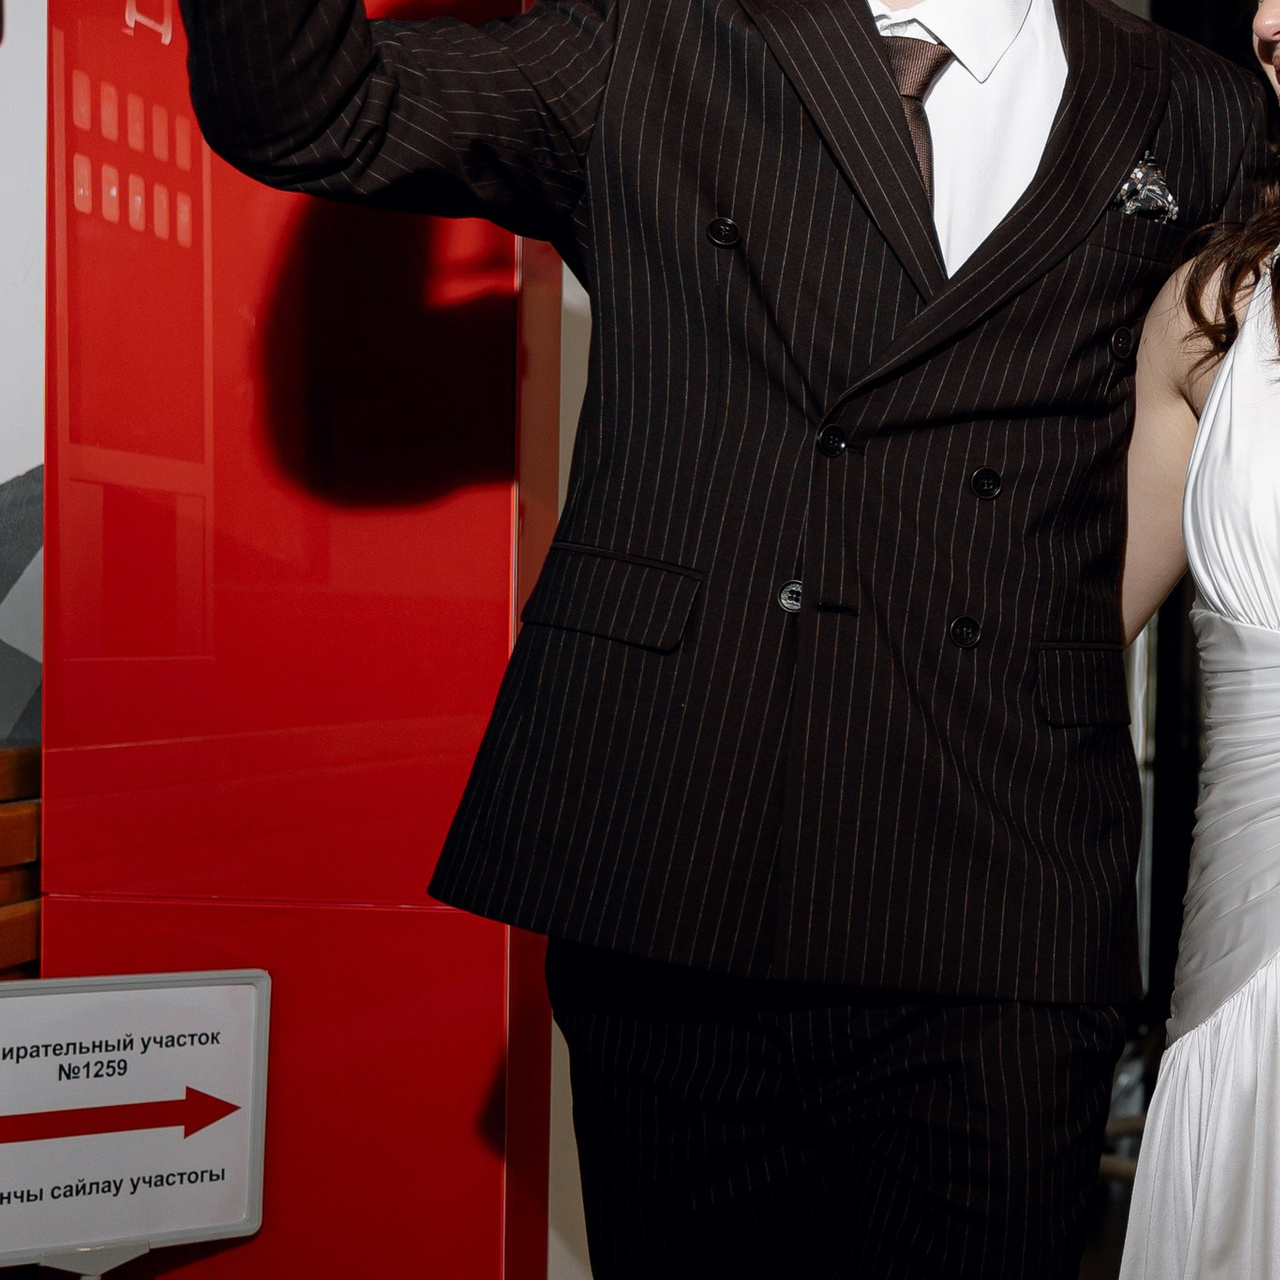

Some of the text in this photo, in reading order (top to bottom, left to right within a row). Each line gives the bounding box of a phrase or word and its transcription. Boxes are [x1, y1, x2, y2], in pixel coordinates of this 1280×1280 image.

[1, 1031, 221, 1064] ирательный участок
[58, 1058, 128, 1081] №1259
[0, 1168, 226, 1206] нчы сайлау участогы
